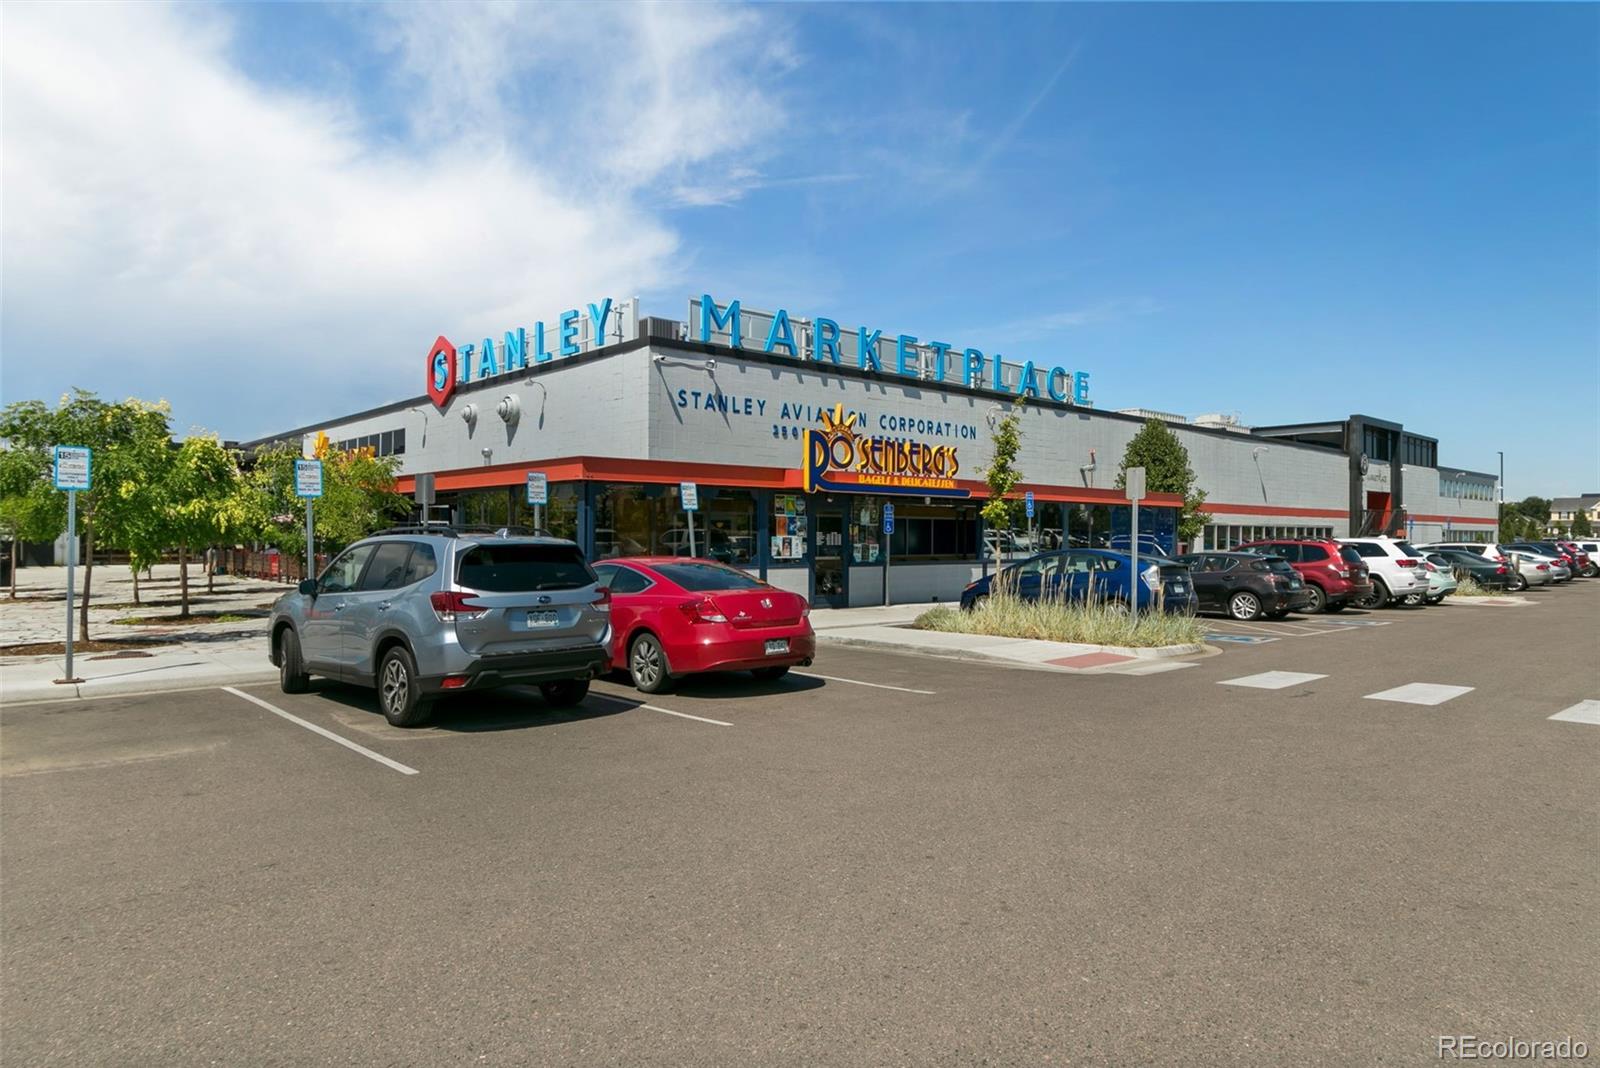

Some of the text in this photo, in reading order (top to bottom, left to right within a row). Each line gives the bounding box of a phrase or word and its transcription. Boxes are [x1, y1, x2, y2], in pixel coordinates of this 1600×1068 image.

[432, 294, 1091, 405] STANLEY MARKETPLACE
[678, 388, 977, 440] STANLEY AVIATN CORPORATION
[803, 430, 960, 494] ROSENBERG'S
[858, 475, 891, 485] BAGELS
[902, 477, 955, 489] DELICATESSEN
